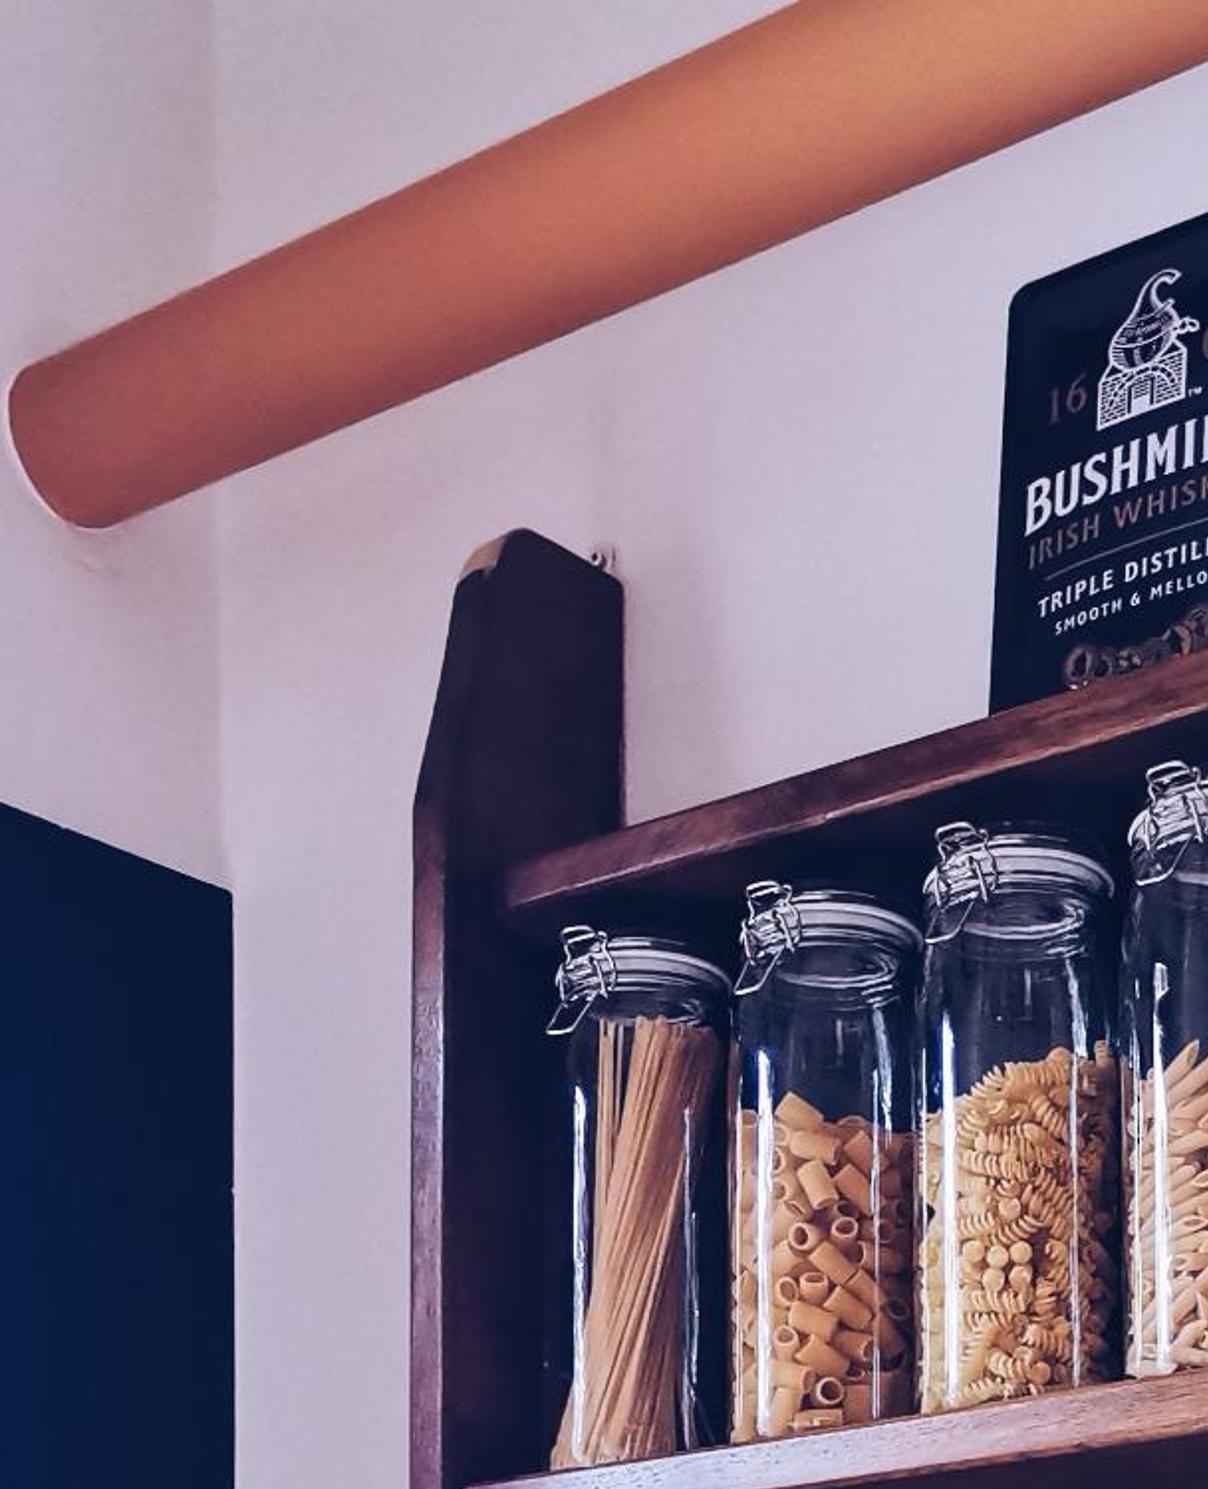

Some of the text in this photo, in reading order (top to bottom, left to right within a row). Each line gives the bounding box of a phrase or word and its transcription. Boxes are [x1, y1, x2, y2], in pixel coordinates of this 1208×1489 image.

[1049, 373, 1088, 424] 16
[1028, 513, 1100, 570] IRISH
[1038, 569, 1115, 618] TRIPLE
[1055, 598, 1122, 636] SMOOTH
[1130, 592, 1141, 606] &
